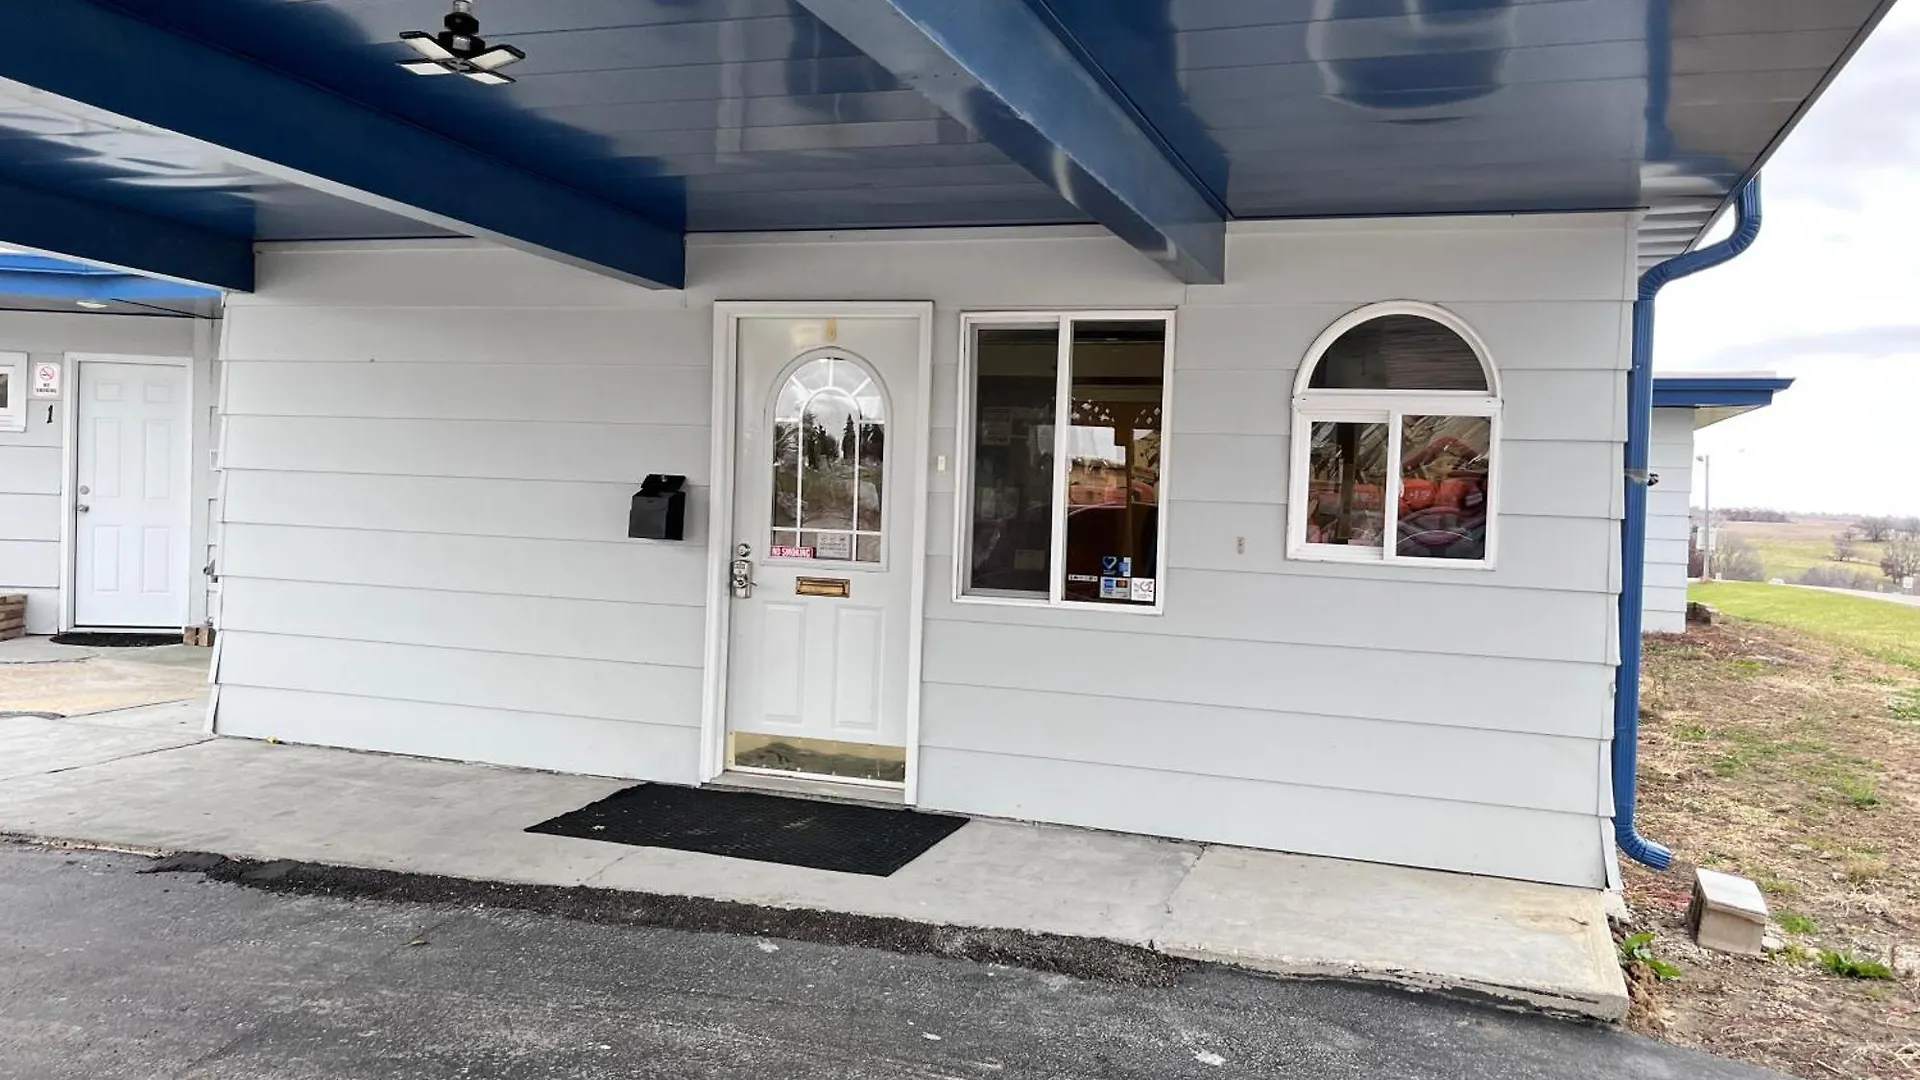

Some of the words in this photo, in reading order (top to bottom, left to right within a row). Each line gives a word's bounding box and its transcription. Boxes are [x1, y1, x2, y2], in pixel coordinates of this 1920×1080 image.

[46, 404, 53, 424] 1
[772, 547, 780, 556] NO
[781, 548, 811, 558] SMOKING
